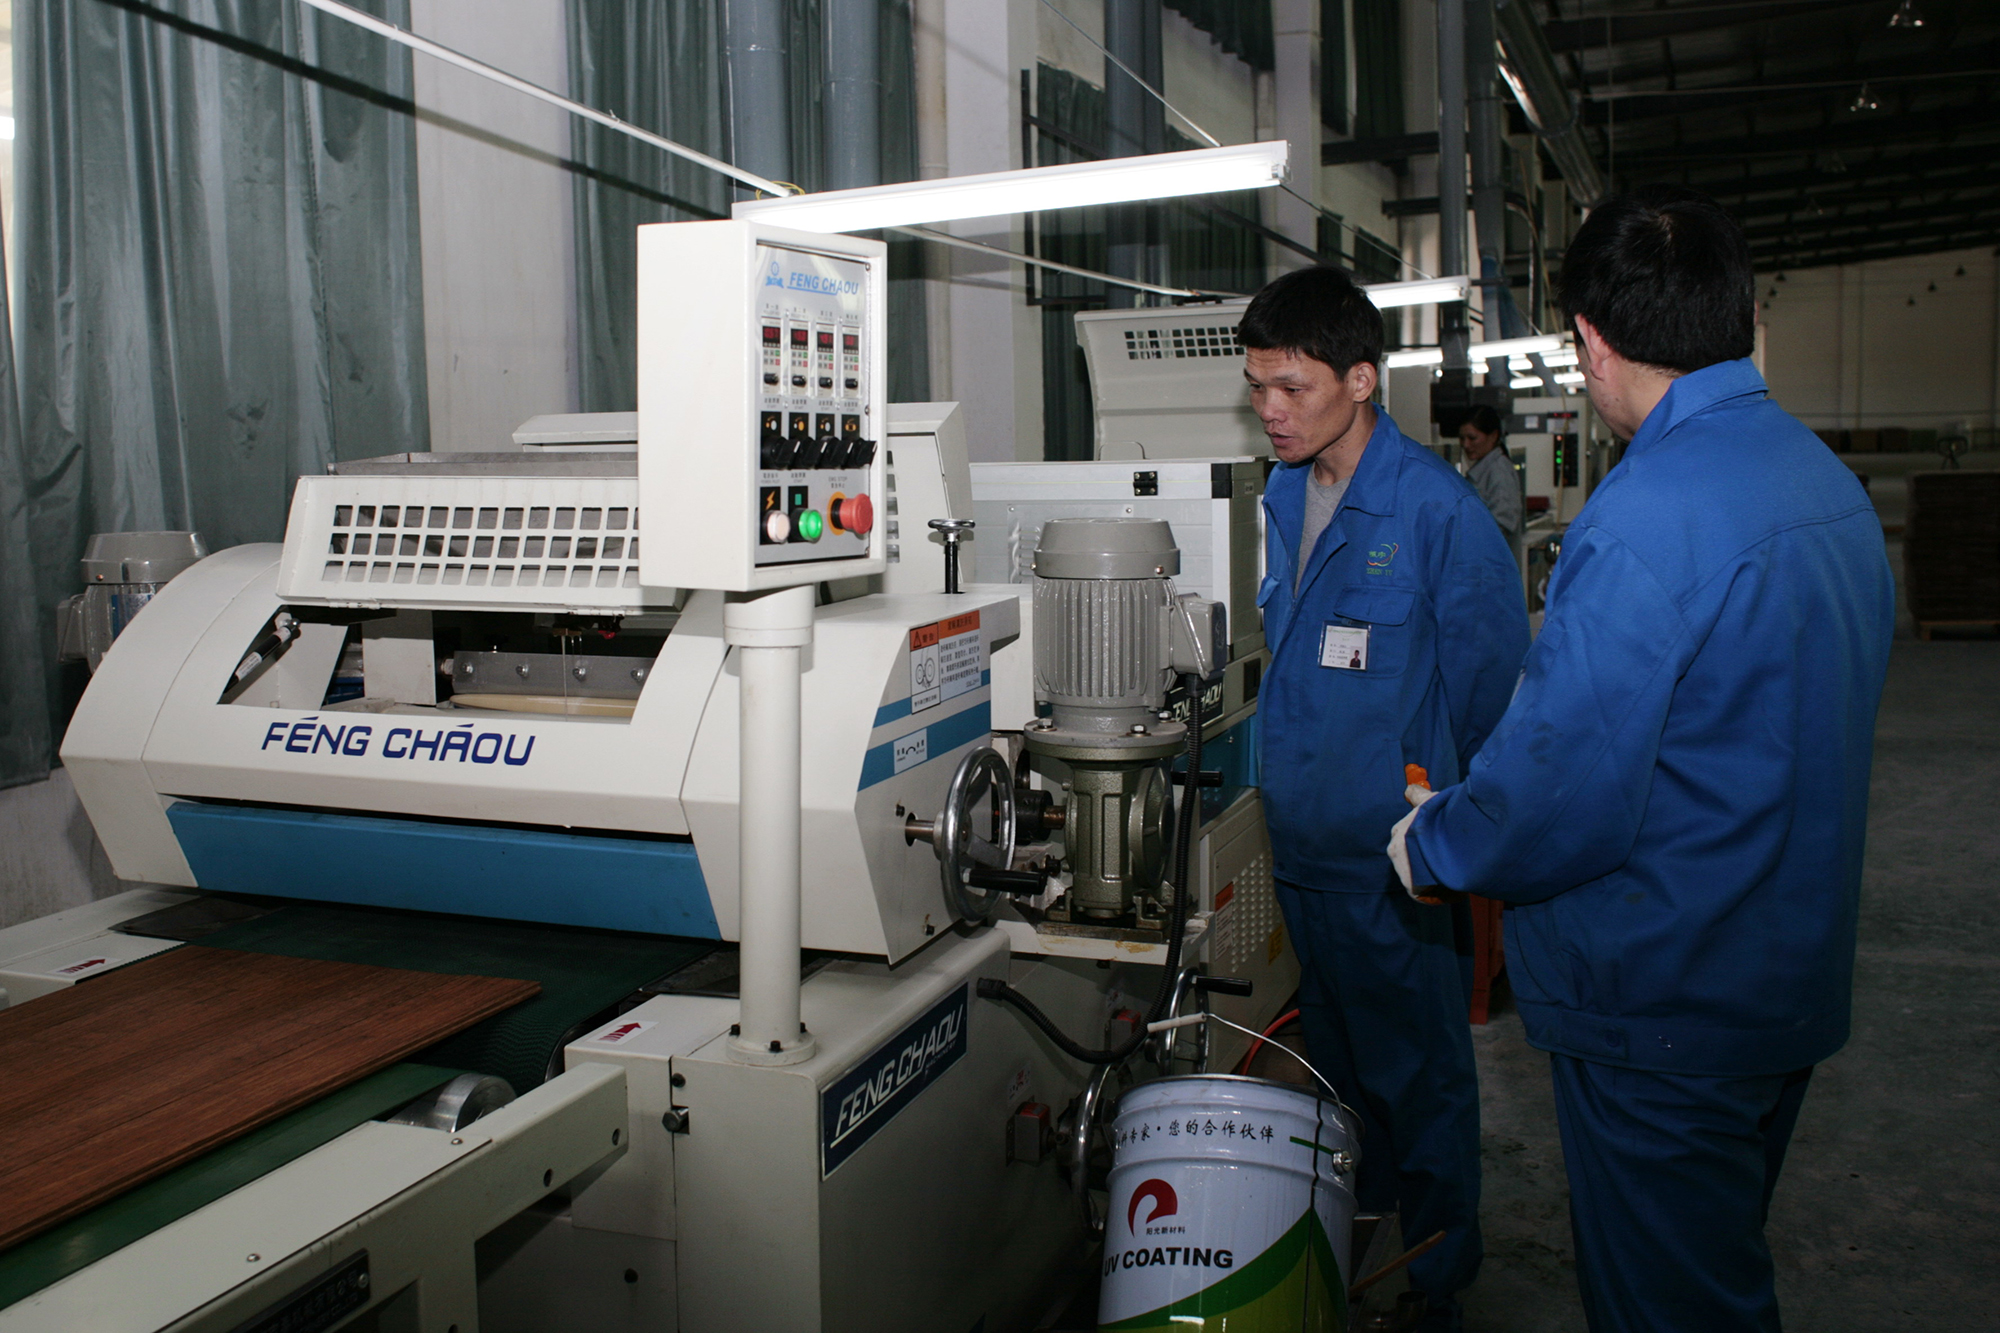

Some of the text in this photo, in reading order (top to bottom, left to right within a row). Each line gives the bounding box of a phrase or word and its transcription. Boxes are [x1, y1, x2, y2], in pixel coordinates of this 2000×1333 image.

[790, 272, 859, 295] FENG CHAOU
[835, 1003, 964, 1138] FENG CHAOU
[1104, 1247, 1233, 1277] UV COATING
